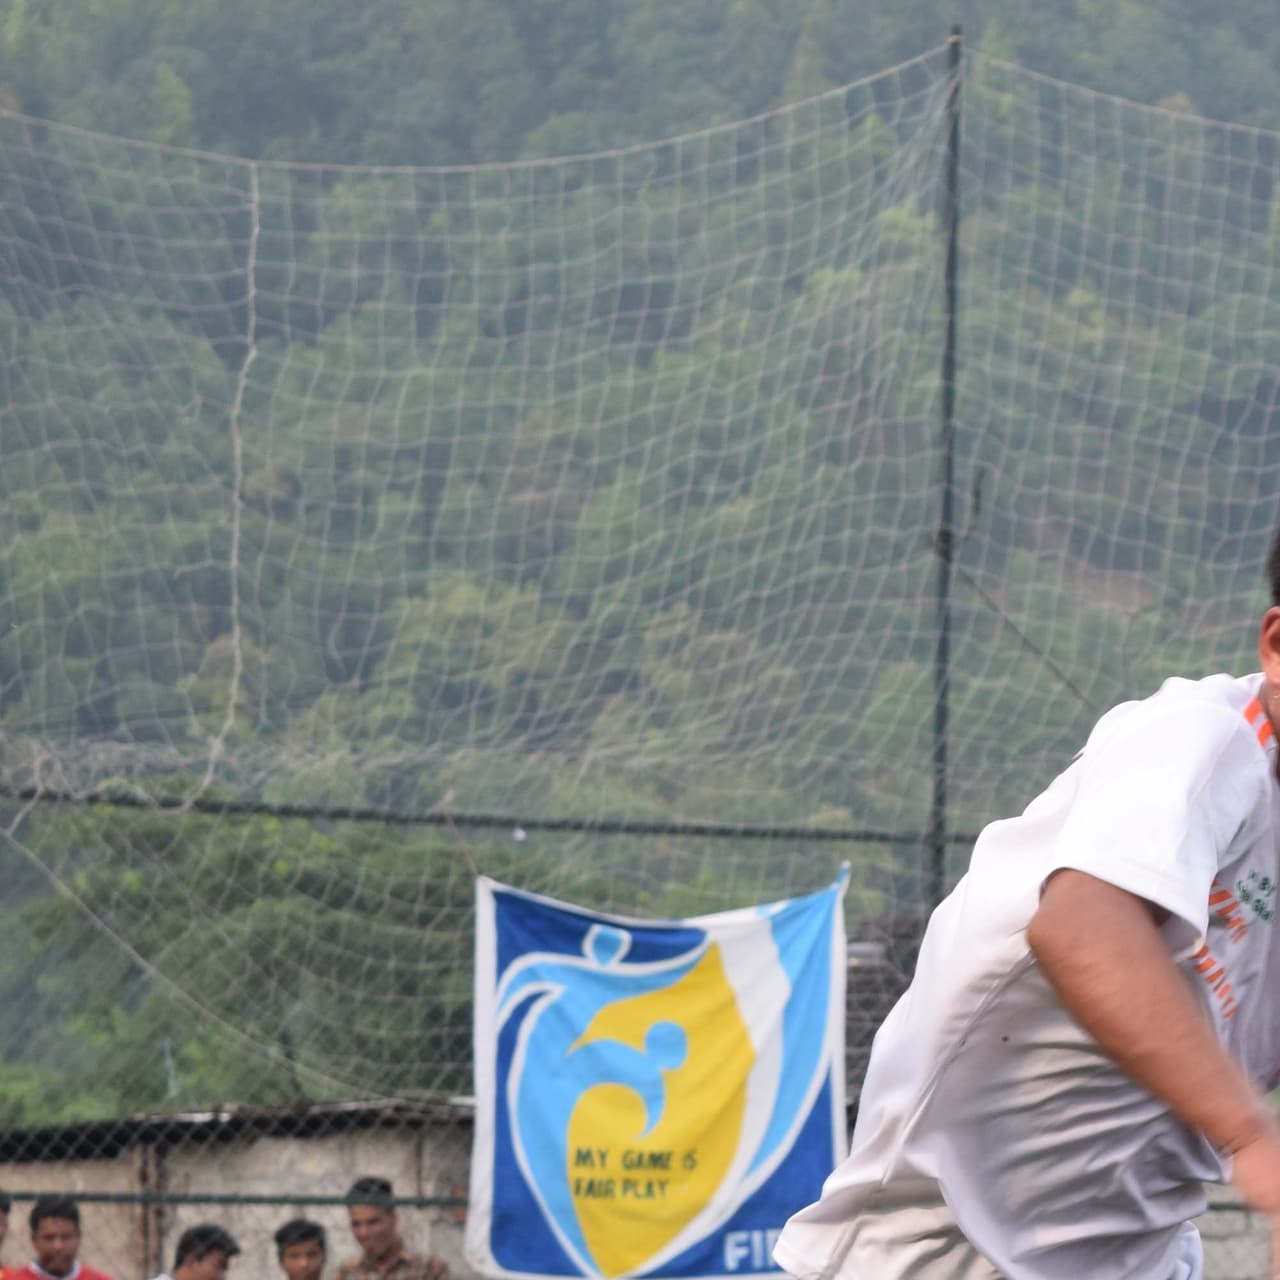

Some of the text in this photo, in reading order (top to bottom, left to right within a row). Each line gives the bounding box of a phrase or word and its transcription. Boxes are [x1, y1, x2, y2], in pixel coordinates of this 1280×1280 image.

[574, 1146, 609, 1169] MY
[621, 1149, 674, 1171] GAME
[574, 1177, 671, 1200] FAIR PLAY
[723, 1227, 783, 1272] FI
